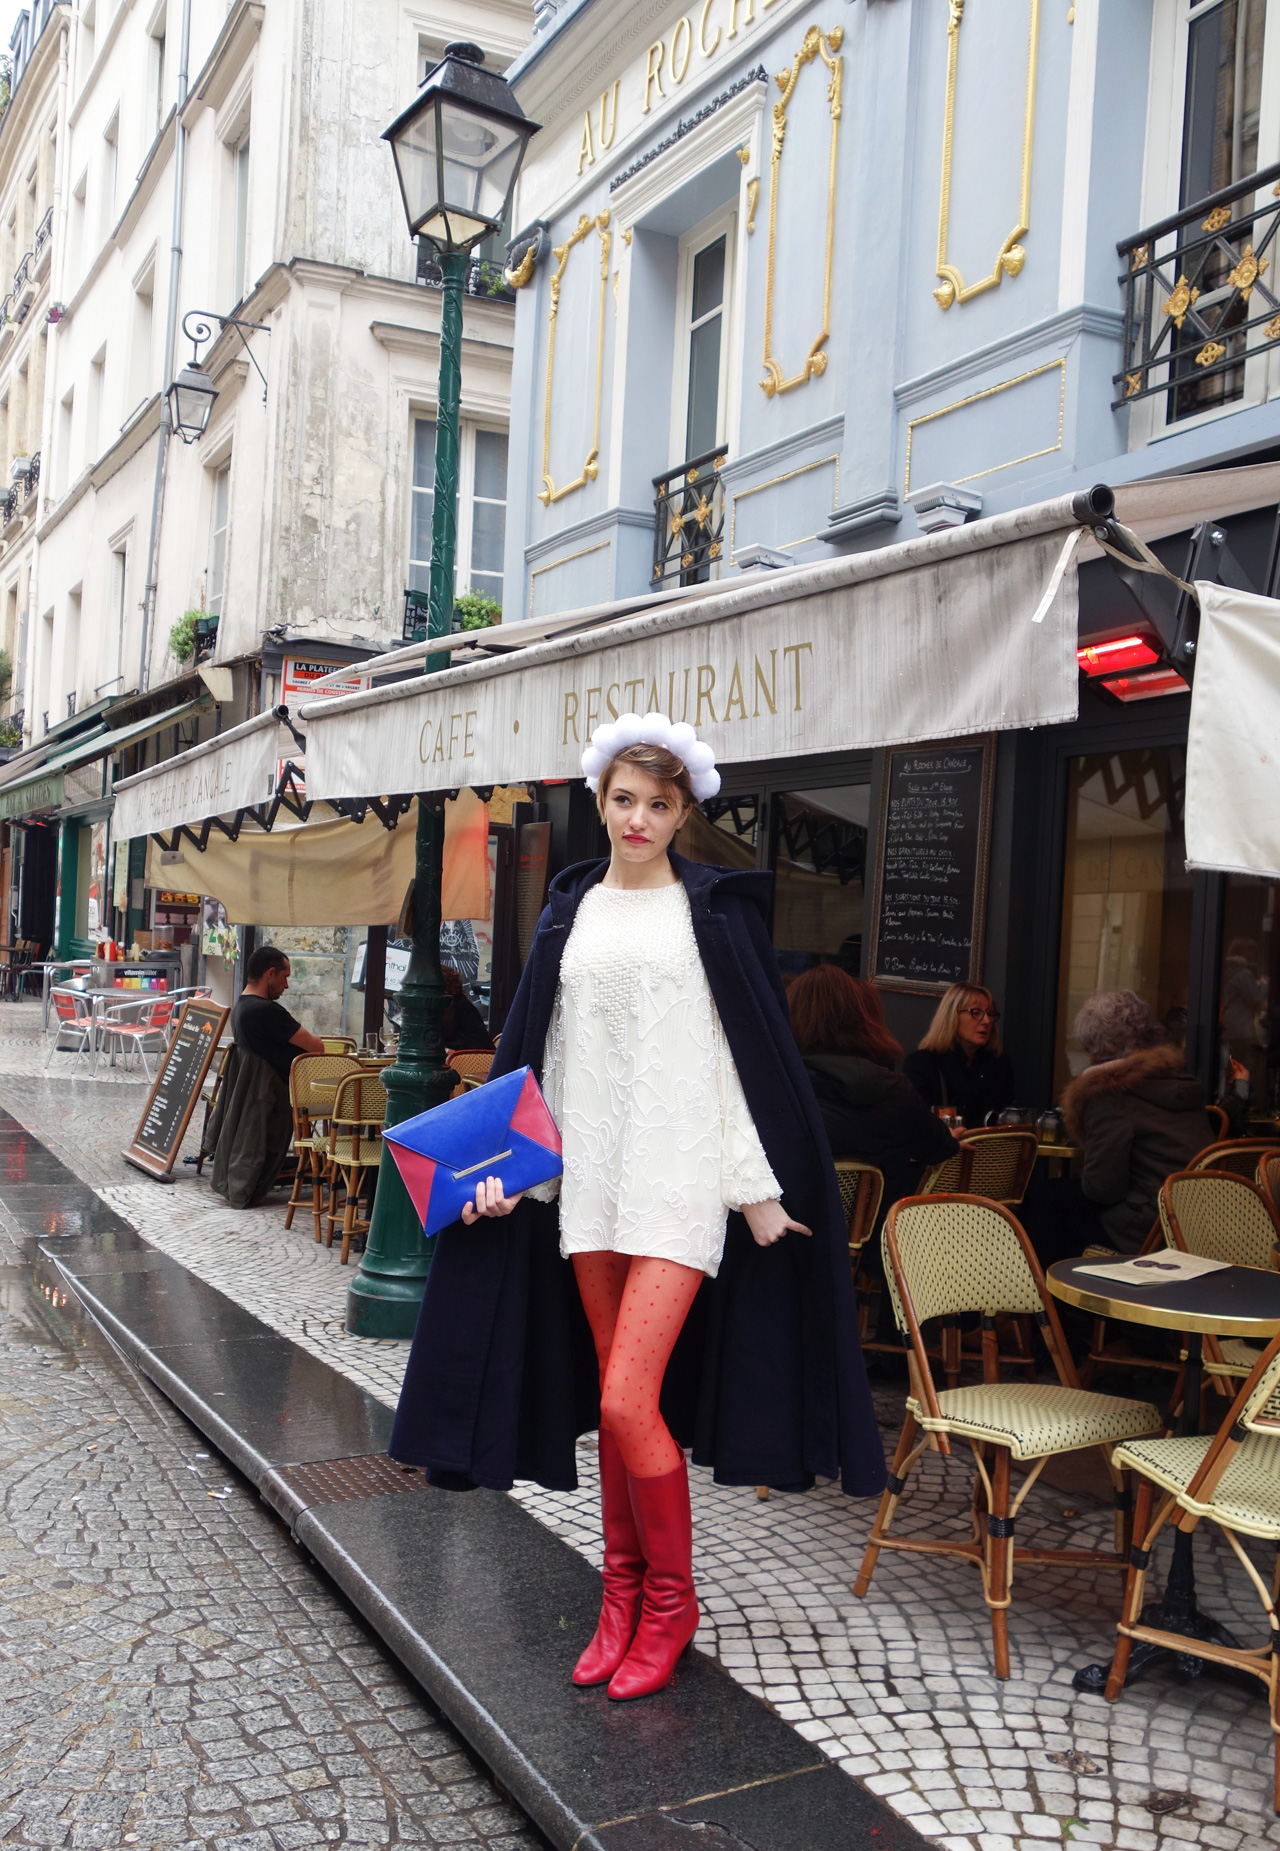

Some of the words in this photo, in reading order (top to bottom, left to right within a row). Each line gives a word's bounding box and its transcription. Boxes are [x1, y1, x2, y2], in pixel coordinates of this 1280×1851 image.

[576, 79, 621, 176] AU
[296, 663, 307, 671] LA
[419, 710, 478, 764] CAFE
[562, 641, 813, 746] RESTAURANT
[191, 761, 232, 804] CANCALE
